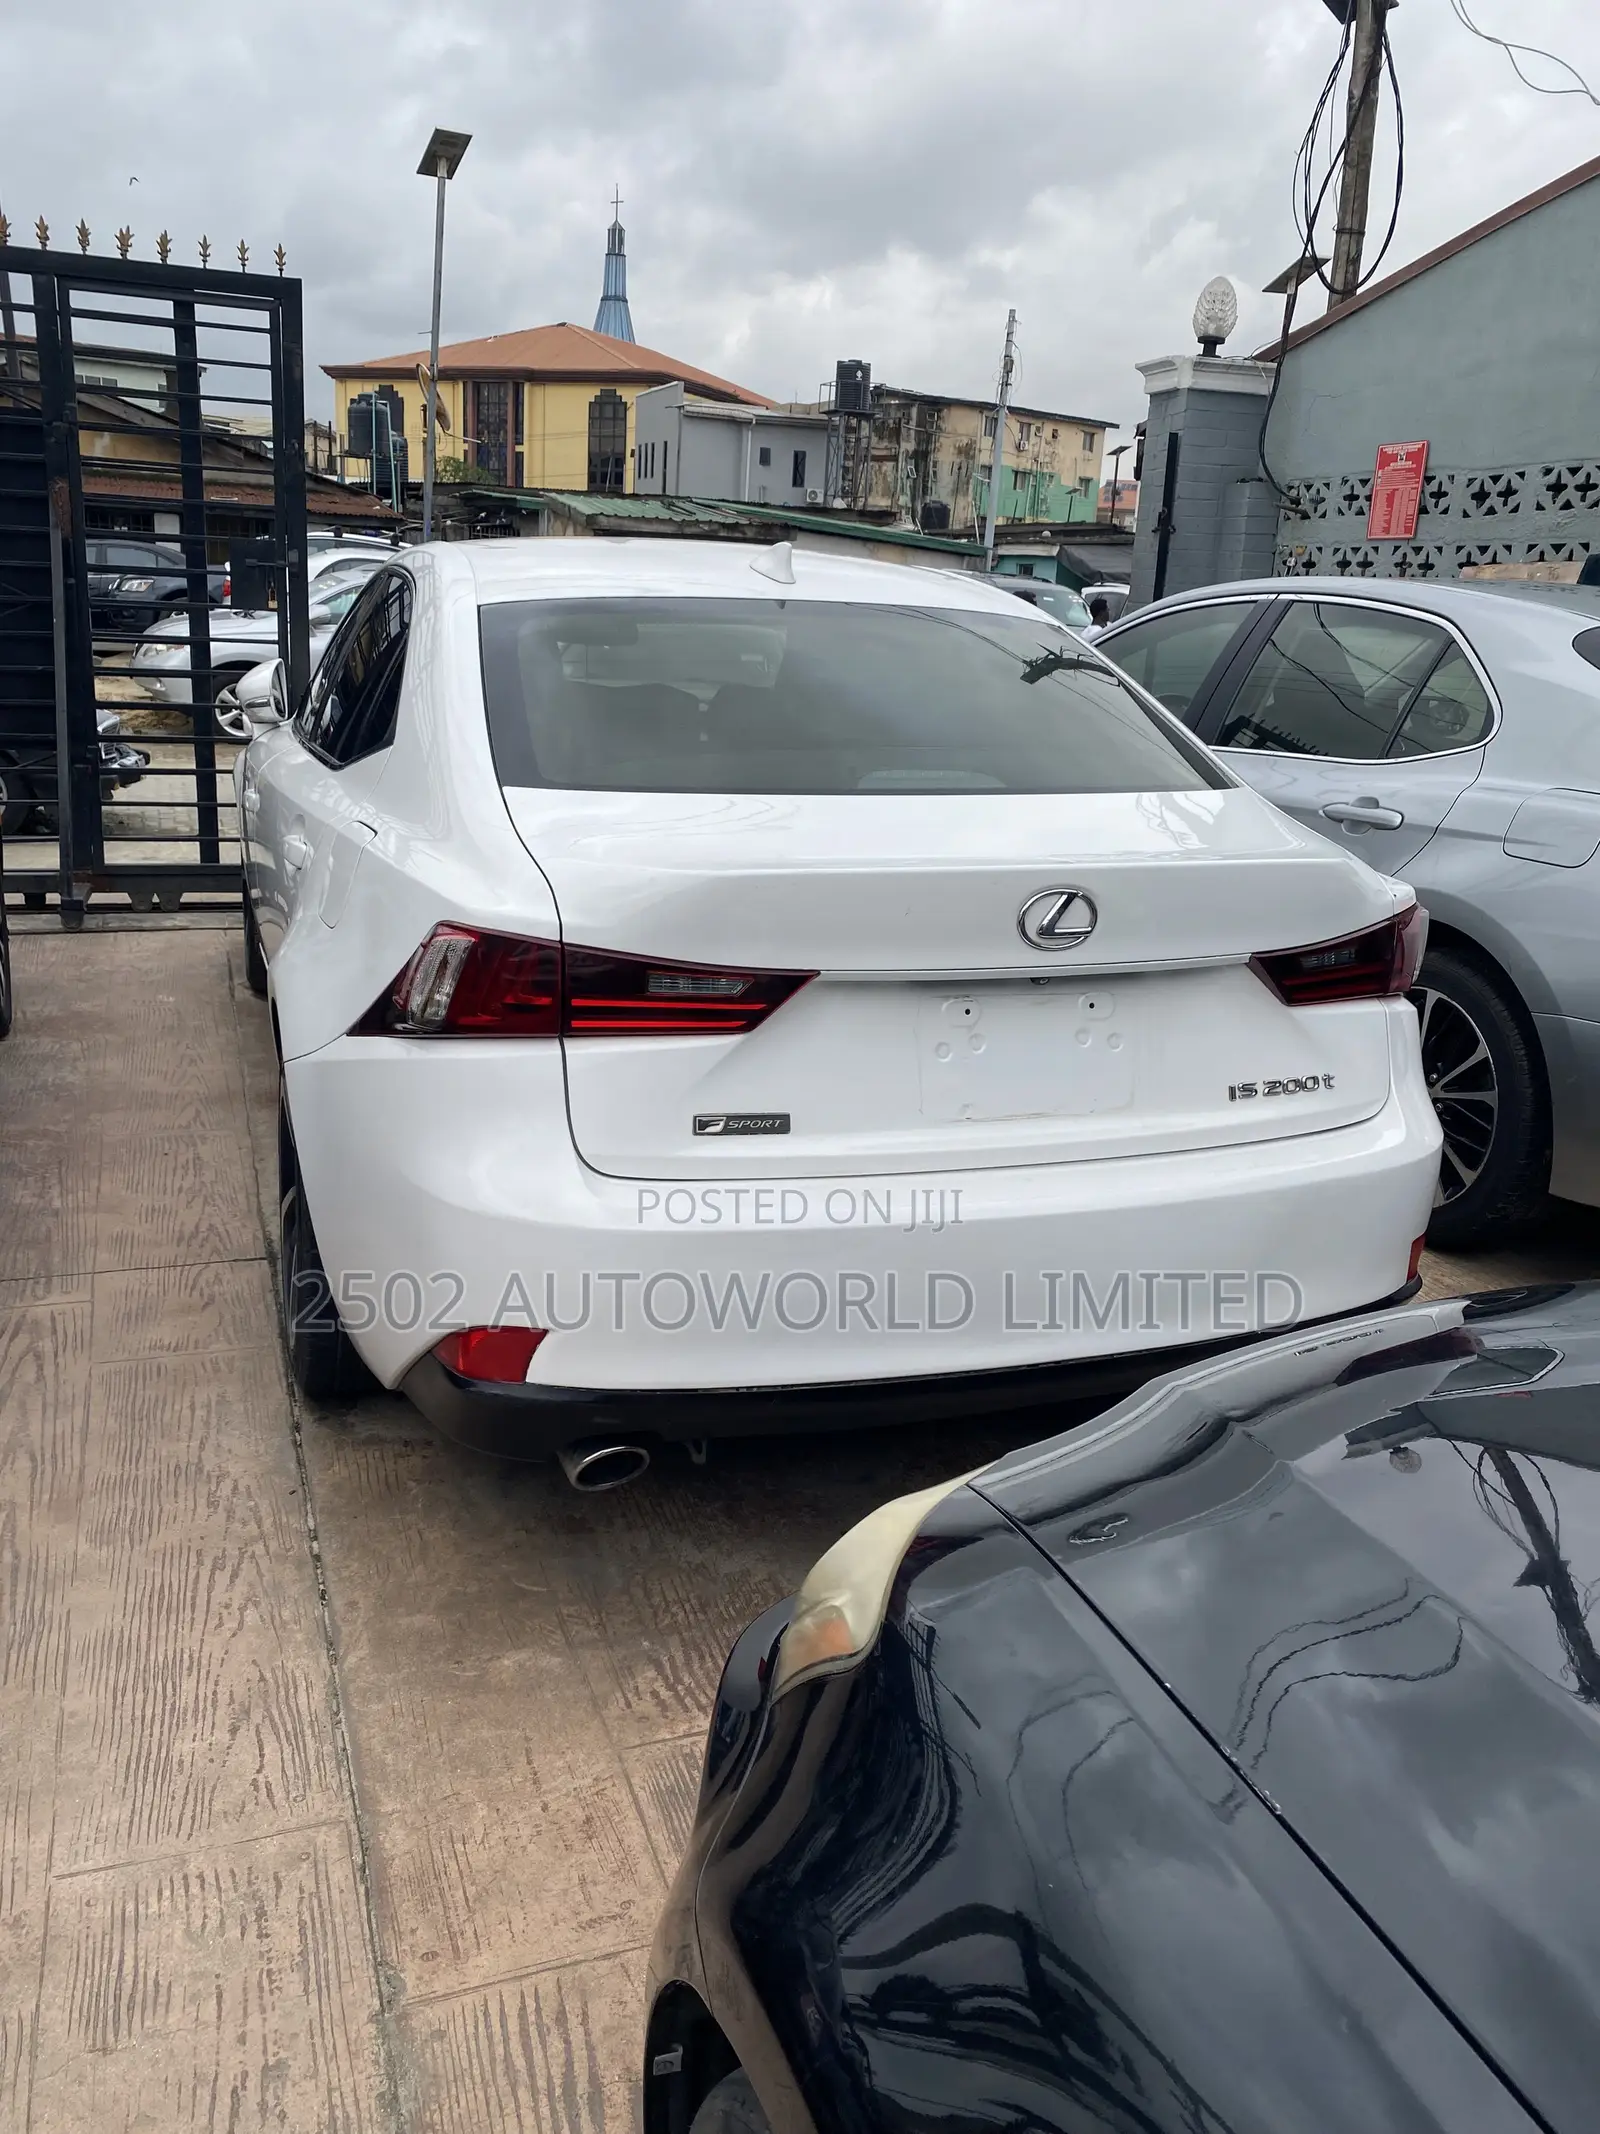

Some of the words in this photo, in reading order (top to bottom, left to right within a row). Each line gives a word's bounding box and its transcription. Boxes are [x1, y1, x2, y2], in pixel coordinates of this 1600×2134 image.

[1228, 1082, 1258, 1102] IS
[1263, 1073, 1335, 1097] 200t
[727, 1119, 784, 1129] SPORT
